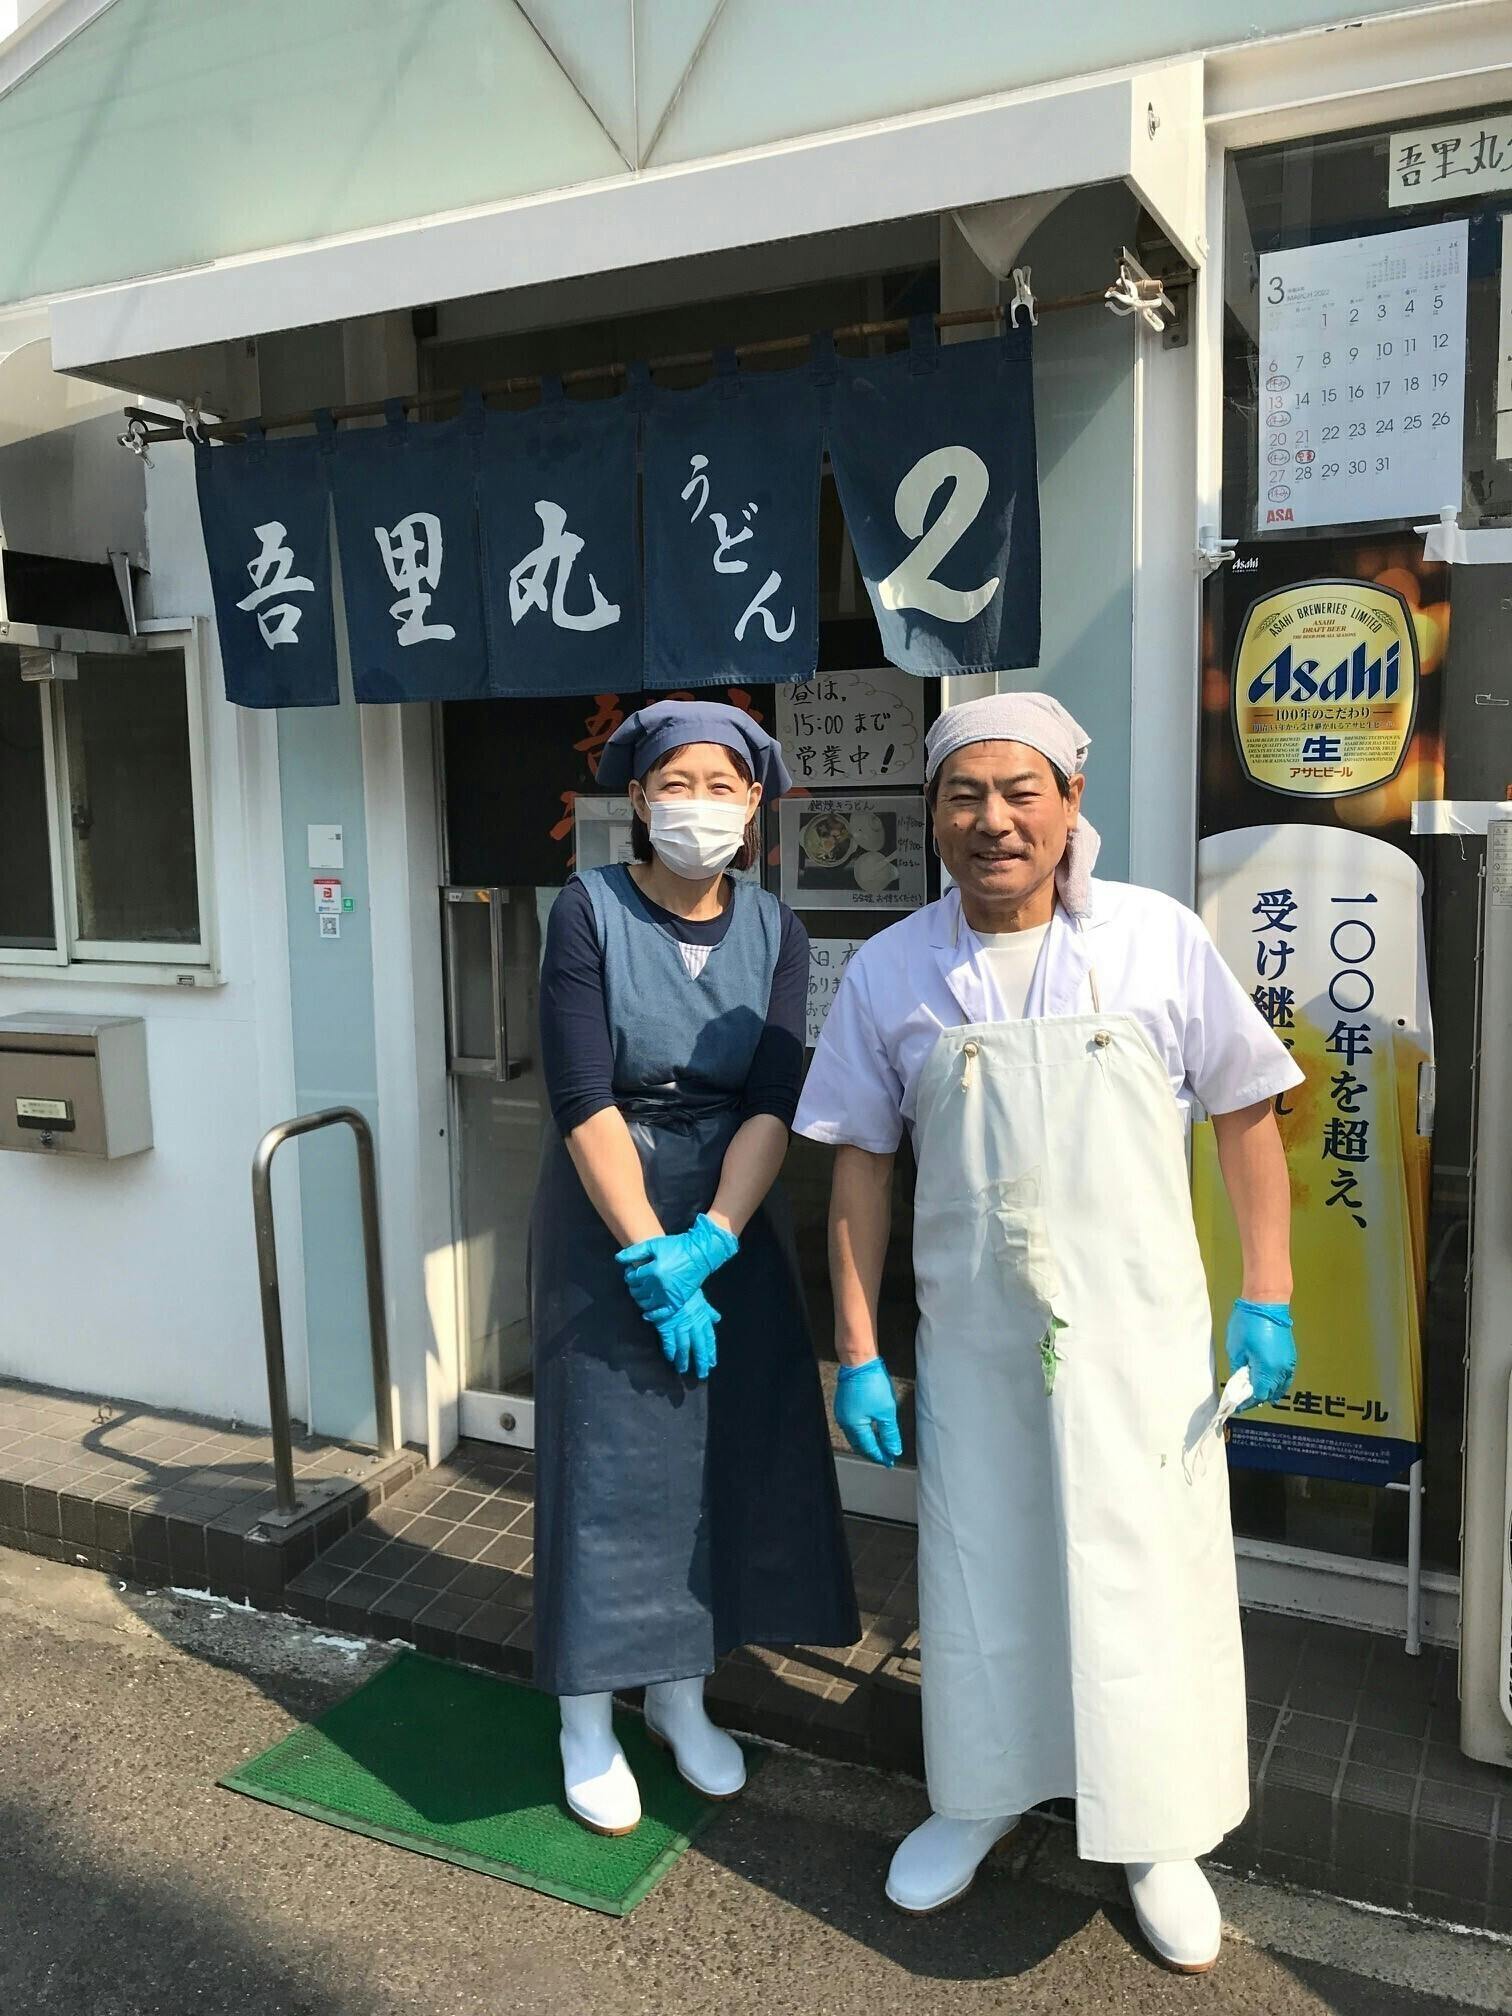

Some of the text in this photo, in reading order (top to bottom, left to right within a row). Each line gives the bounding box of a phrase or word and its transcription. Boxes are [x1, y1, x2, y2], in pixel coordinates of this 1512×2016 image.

[1267, 276, 1285, 305] 3
[1322, 295, 1444, 328] 1 2 3 4 5
[1269, 334, 1449, 373] 6 7 8 9 10 11 12
[1269, 372, 1448, 409] 13 14 15 16 17 18 19
[1269, 411, 1451, 447] 20 21 22 23 24 25 26
[1269, 457, 1390, 484] 27 28 29 30 31
[1266, 508, 1294, 524] ASA
[680, 453, 796, 643] うどん
[877, 445, 999, 624] 2
[235, 500, 621, 650] 吾里丸
[1232, 557, 1259, 570] Asahi
[1268, 602, 1383, 637] ASAHI BREWERIES LIMITED
[1302, 626, 1326, 634] DRAFT
[1248, 640, 1401, 704] Asahi
[793, 712, 891, 736] 15:00 まで
[1275, 707, 1370, 721] 100年のこだわり
[796, 744, 895, 777] 営業中!
[1302, 736, 1341, 762] 生
[1290, 767, 1353, 778] アサヒビール
[1251, 888, 1298, 1115] 受け継
